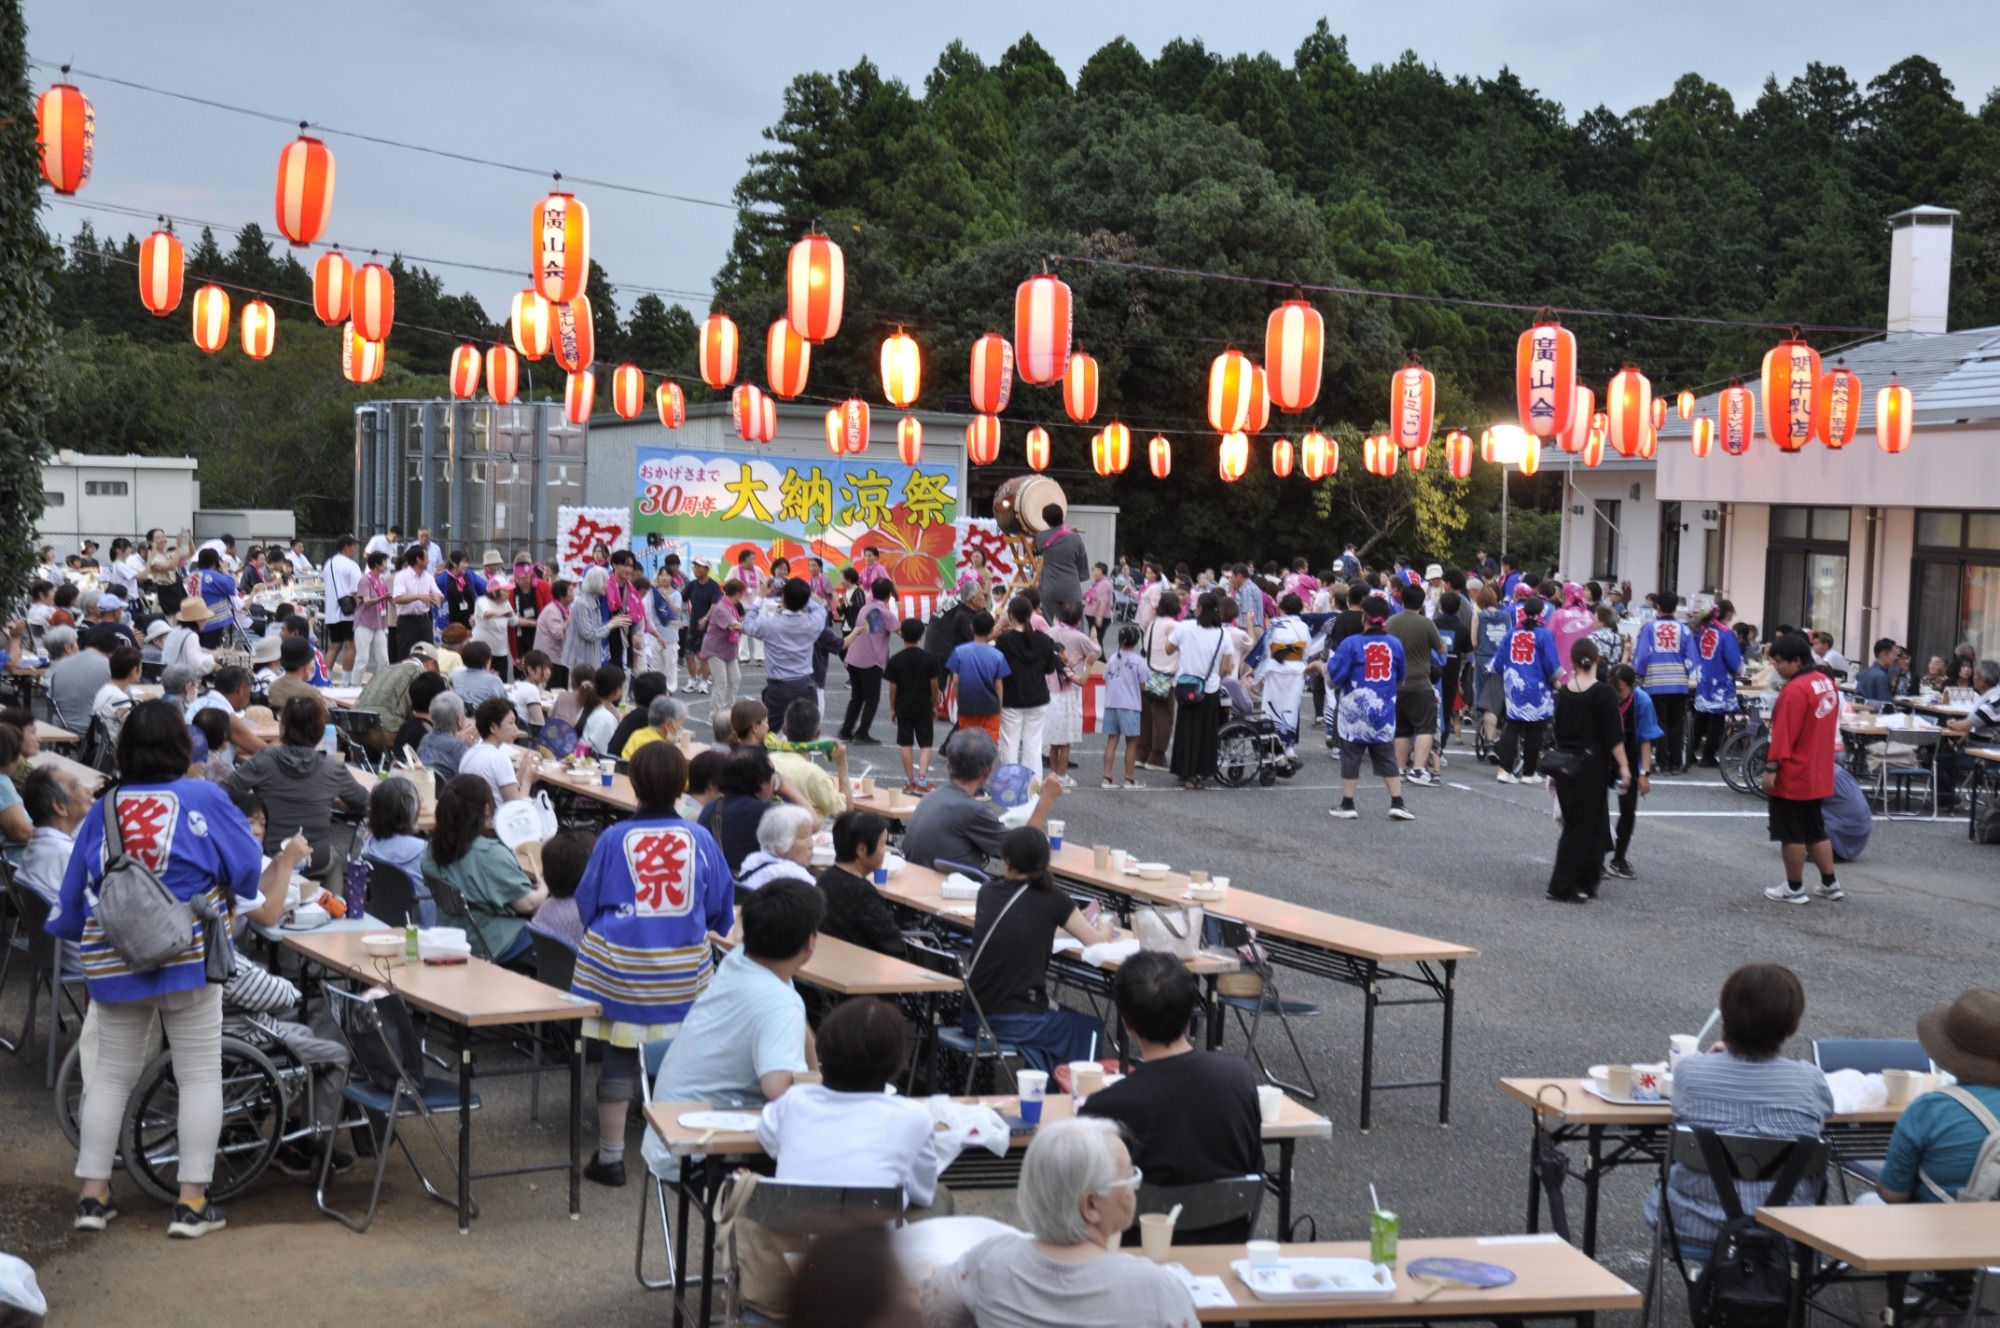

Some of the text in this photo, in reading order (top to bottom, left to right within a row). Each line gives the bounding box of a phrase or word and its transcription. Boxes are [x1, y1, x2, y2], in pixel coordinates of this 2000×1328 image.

[543, 208, 565, 280] 廣山会
[1529, 337, 1556, 419] 廣山会
[639, 464, 721, 483] おかげさまで
[639, 484, 717, 518] 30周年
[720, 464, 956, 529] 大納涼祭
[1511, 632, 1535, 662] 祭
[1656, 623, 1679, 650] 祭
[1701, 629, 1717, 658] 祭
[1365, 643, 1391, 679] 祭
[633, 832, 687, 910] 祭
[1638, 1072, 1657, 1089] 氷
